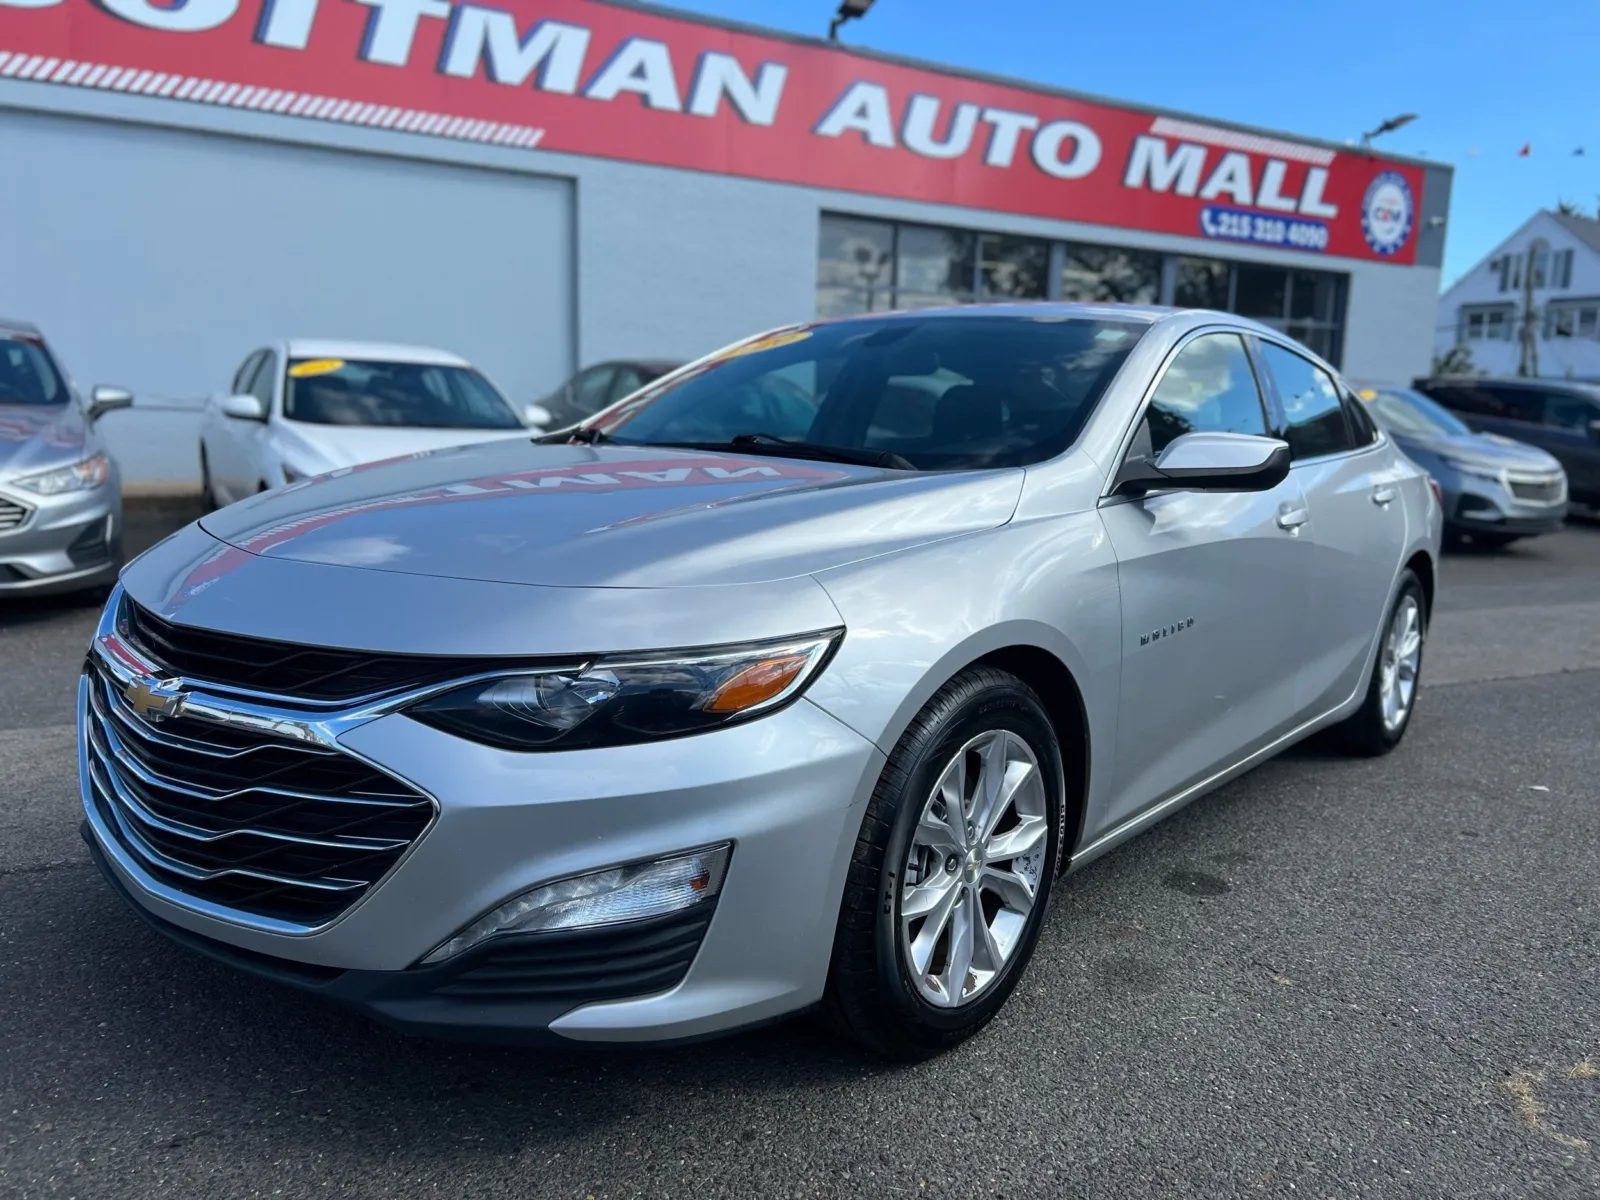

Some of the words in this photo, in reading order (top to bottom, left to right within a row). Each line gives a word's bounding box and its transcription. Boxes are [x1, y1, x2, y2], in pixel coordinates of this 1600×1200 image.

[0, 0, 787, 126] TMAN
[814, 80, 1101, 179] AUTO
[1123, 135, 1338, 218] MALL
